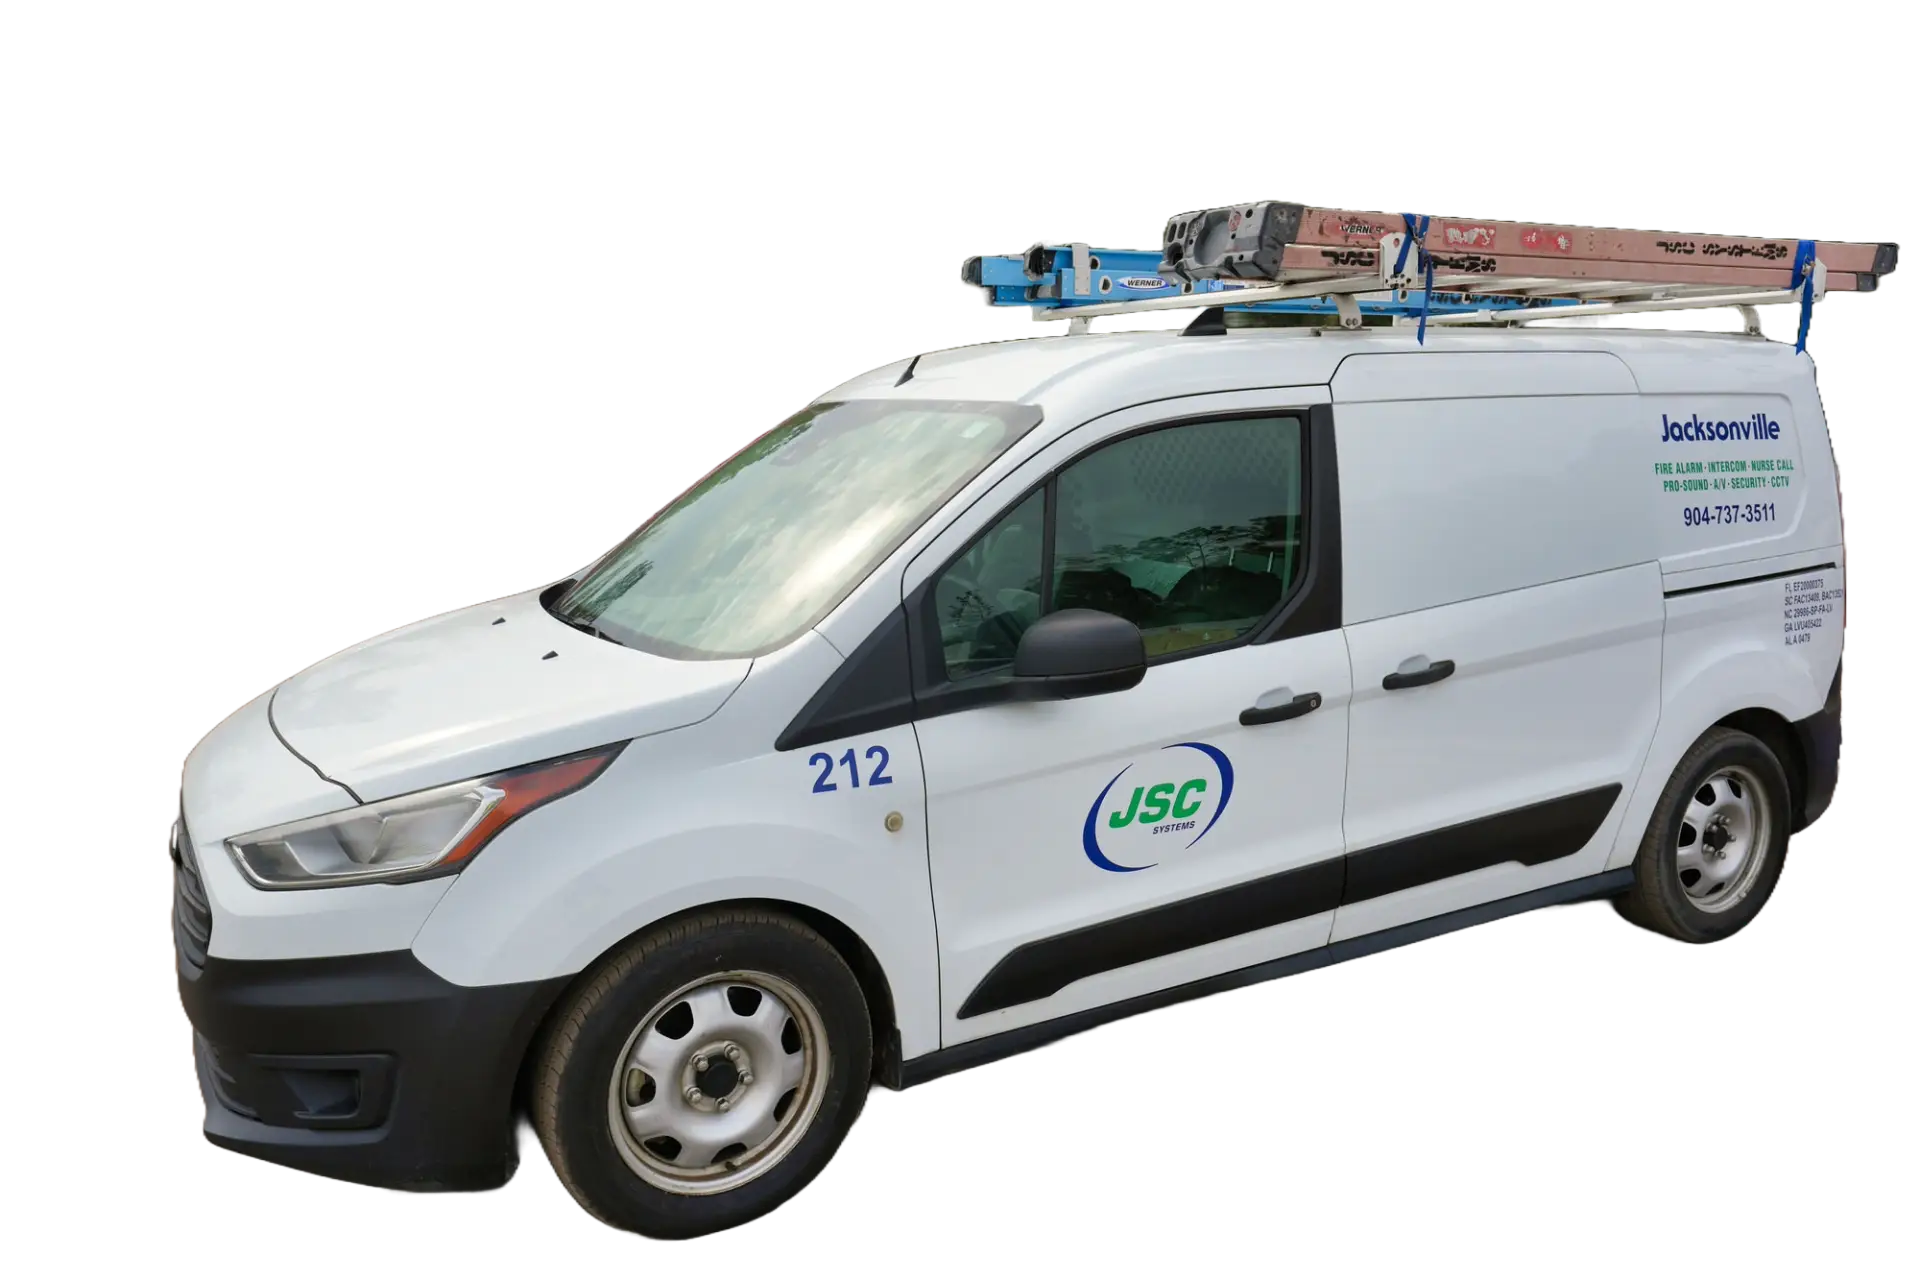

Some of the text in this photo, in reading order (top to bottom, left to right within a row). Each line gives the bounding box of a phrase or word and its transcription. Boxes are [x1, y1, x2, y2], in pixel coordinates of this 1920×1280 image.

[1127, 279, 1163, 288] WERNER
[1661, 413, 1781, 443] Jacksonville
[1654, 459, 1794, 475] FIRE ALARM INTERCOM NURSE CALL
[1663, 475, 1790, 492] PRO-SOUND A/V SECURITY CCTV
[1683, 502, 1776, 527] 904-737-3511
[1784, 622, 1793, 633] GA
[808, 745, 893, 794] 212
[1108, 778, 1207, 829] JSC
[1152, 820, 1197, 835] SYSTEMS
